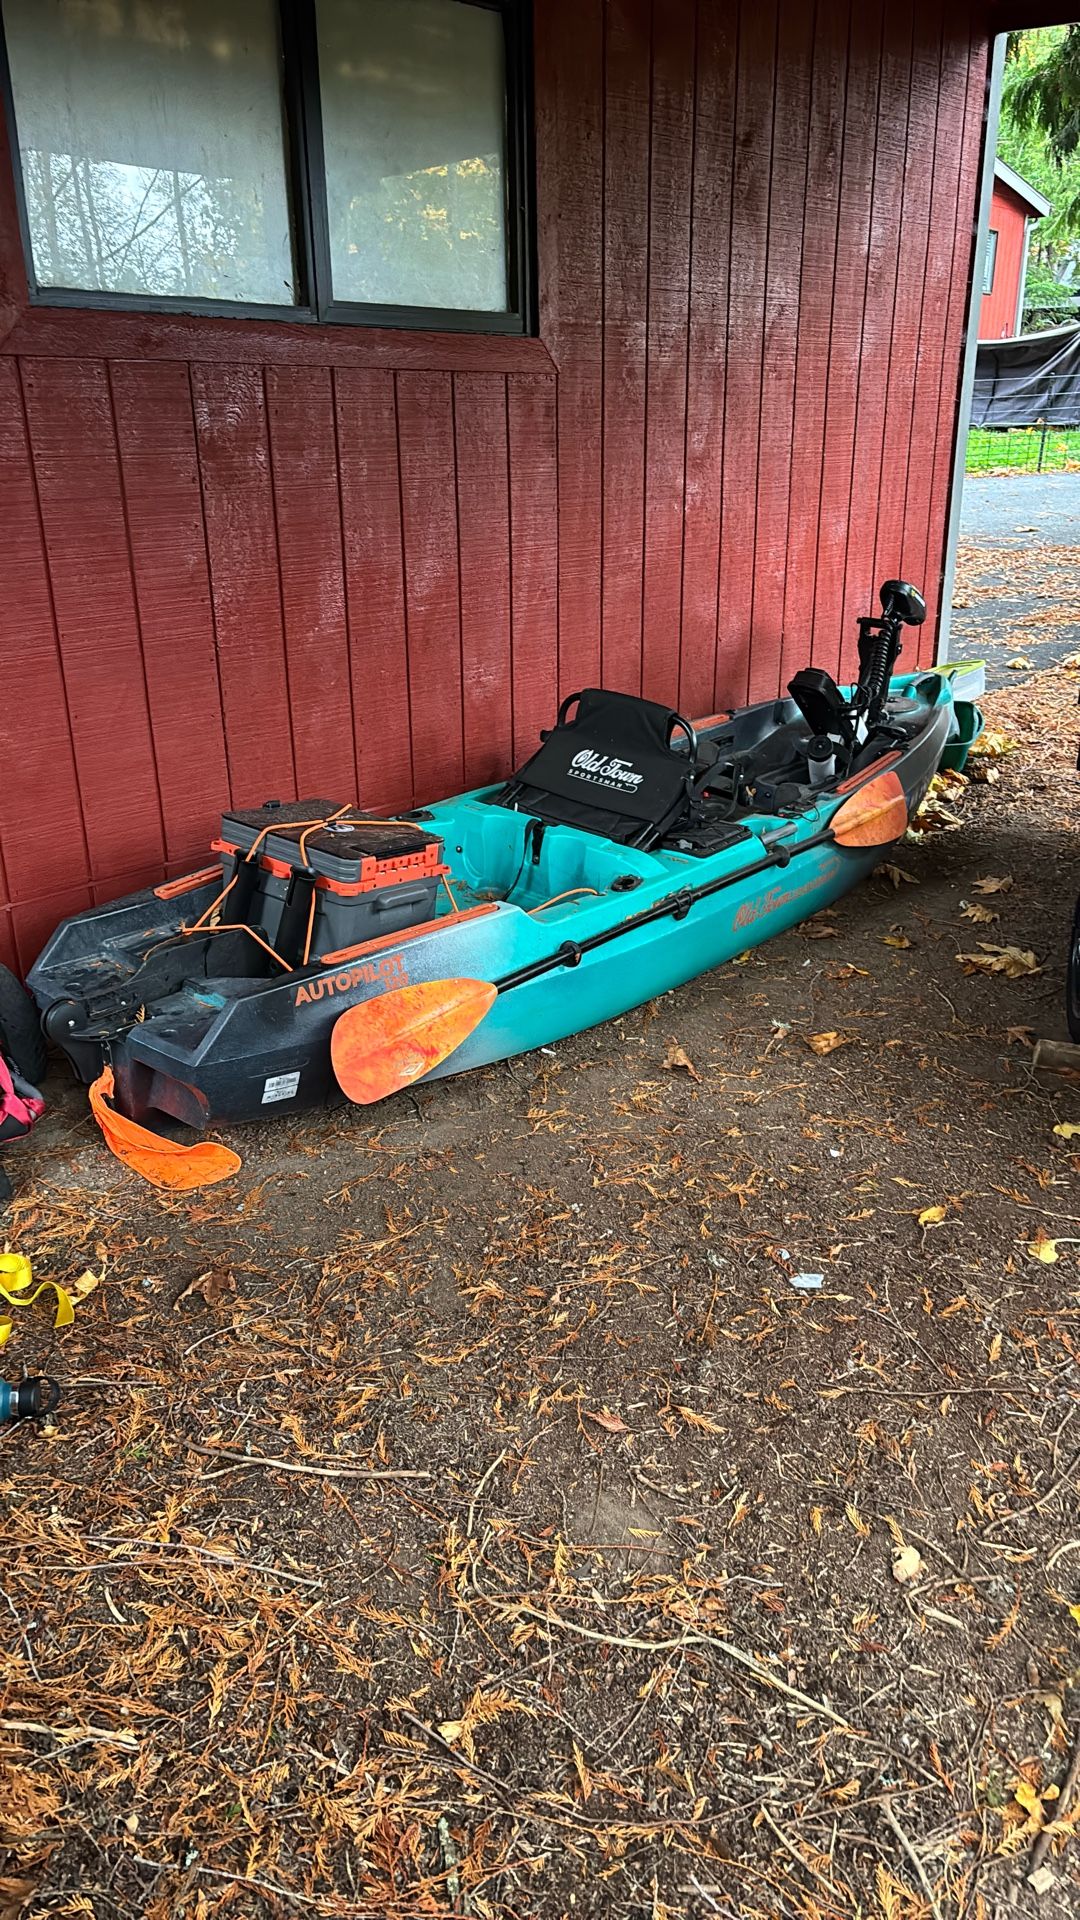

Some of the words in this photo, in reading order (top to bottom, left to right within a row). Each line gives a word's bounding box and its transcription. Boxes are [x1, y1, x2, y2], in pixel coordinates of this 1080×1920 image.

[567, 768, 623, 788] SPORTSMAN
[571, 749, 609, 773] Old
[600, 758, 644, 784] Town
[294, 953, 404, 1007] AUTOPILOT
